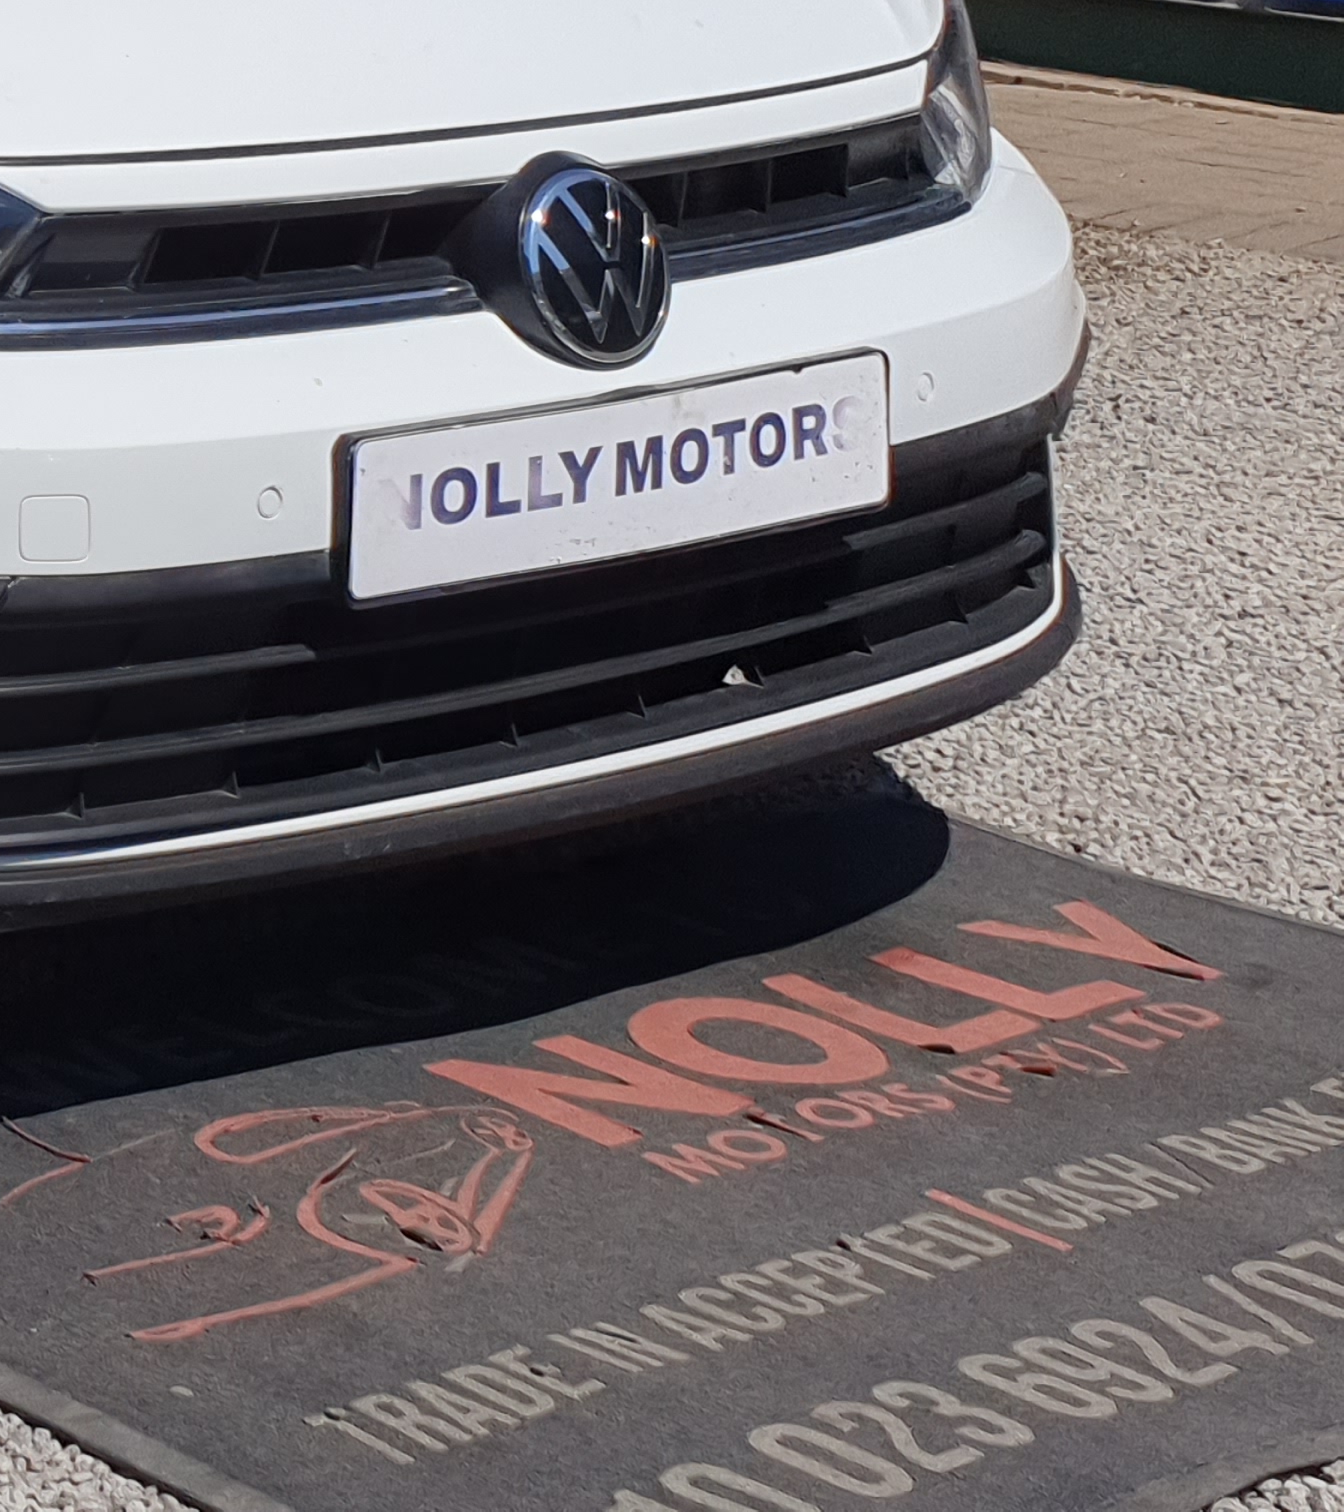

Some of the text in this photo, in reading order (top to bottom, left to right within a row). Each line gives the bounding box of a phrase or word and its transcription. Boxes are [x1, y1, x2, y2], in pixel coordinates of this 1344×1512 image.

[423, 899, 1223, 1149] NOLLY
[642, 1083, 956, 1184] MOTORS
[1089, 1002, 1223, 1050] LTD
[303, 1344, 606, 1465] TRADE
[547, 1321, 691, 1372] IN
[639, 1212, 1013, 1351] ACCEPTED
[748, 1380, 1035, 1499] 023
